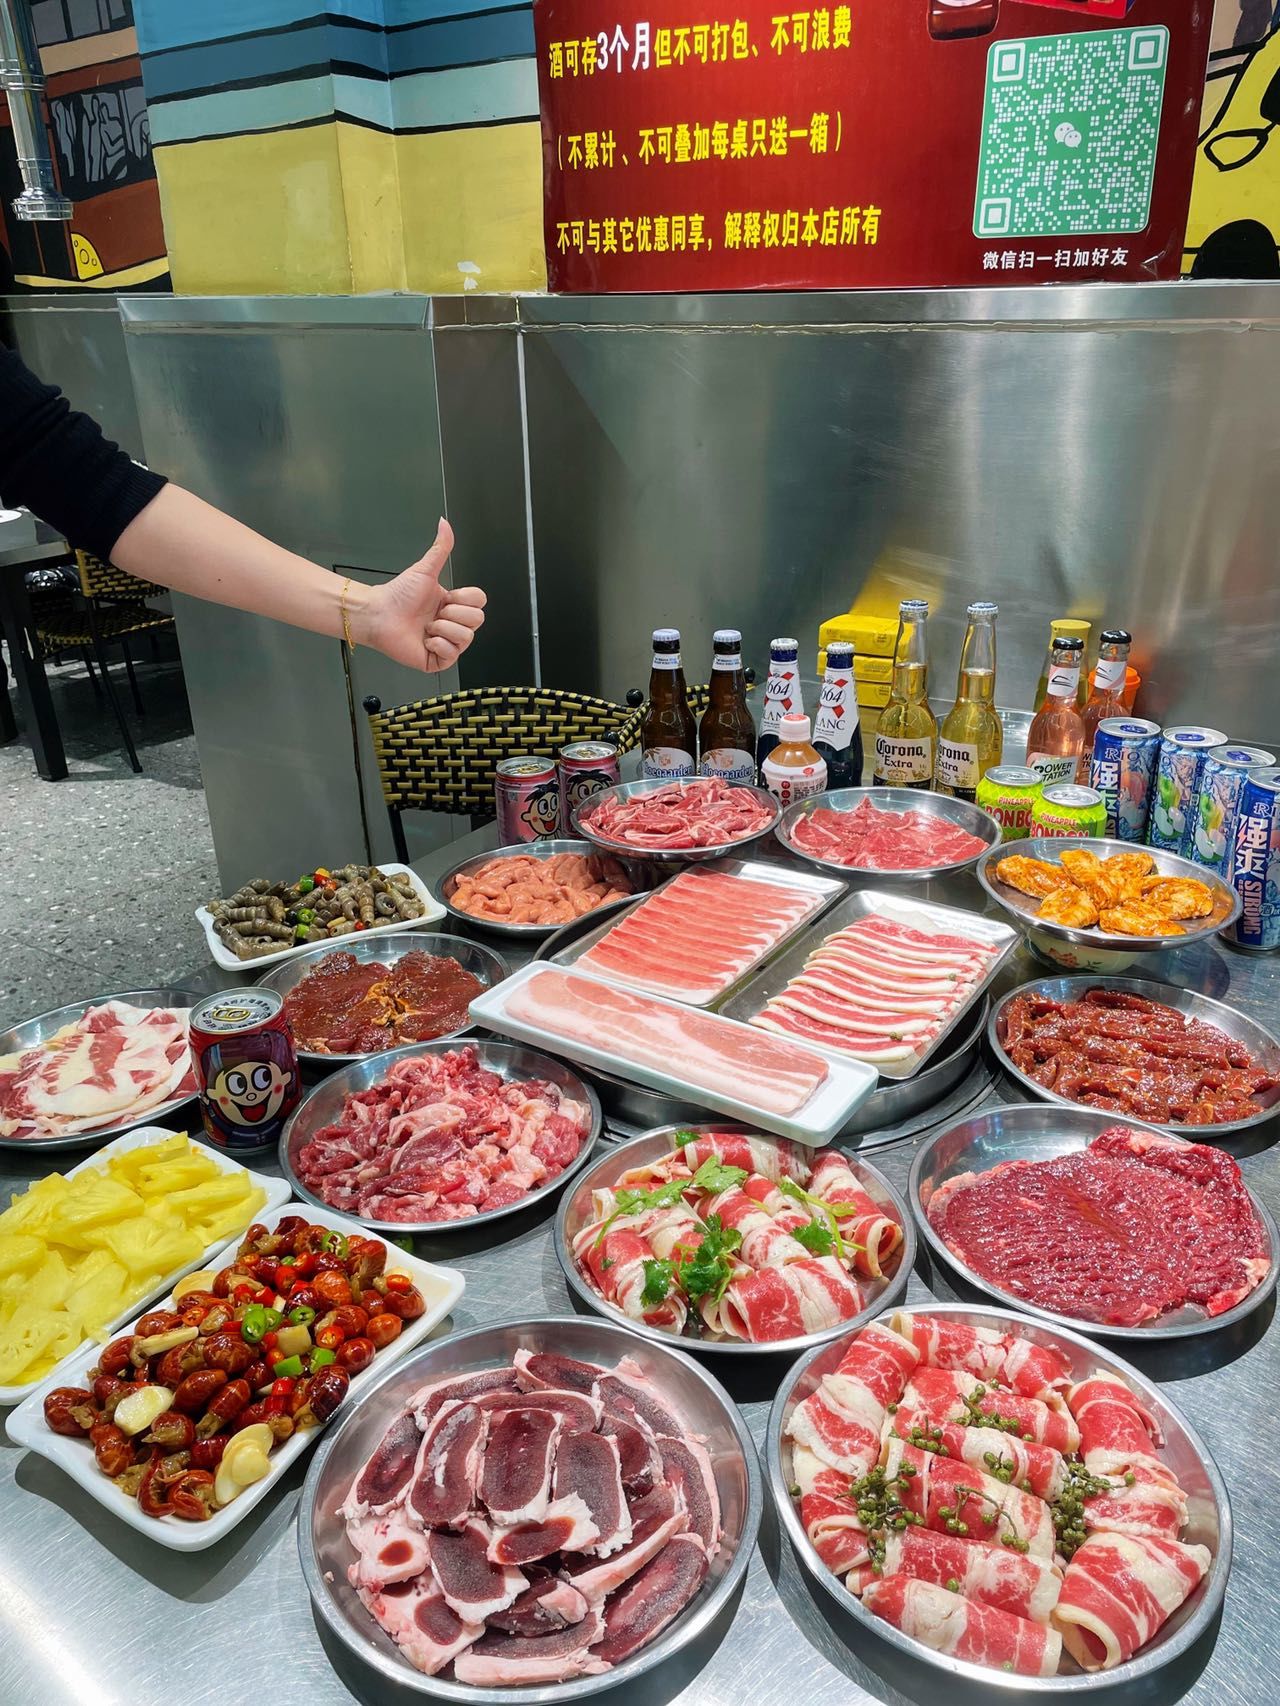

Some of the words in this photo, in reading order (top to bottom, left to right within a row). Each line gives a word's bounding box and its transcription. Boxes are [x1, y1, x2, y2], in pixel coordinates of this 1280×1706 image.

[982, 248, 1129, 270] 微信扫一扫加好友
[876, 738, 923, 757] Corona
[882, 754, 913, 769] Extra
[1040, 769, 1071, 782] TATION
[985, 805, 1032, 828] BONBO
[1040, 812, 1077, 826] PINEAPPLE
[1244, 880, 1262, 935] STRONG
